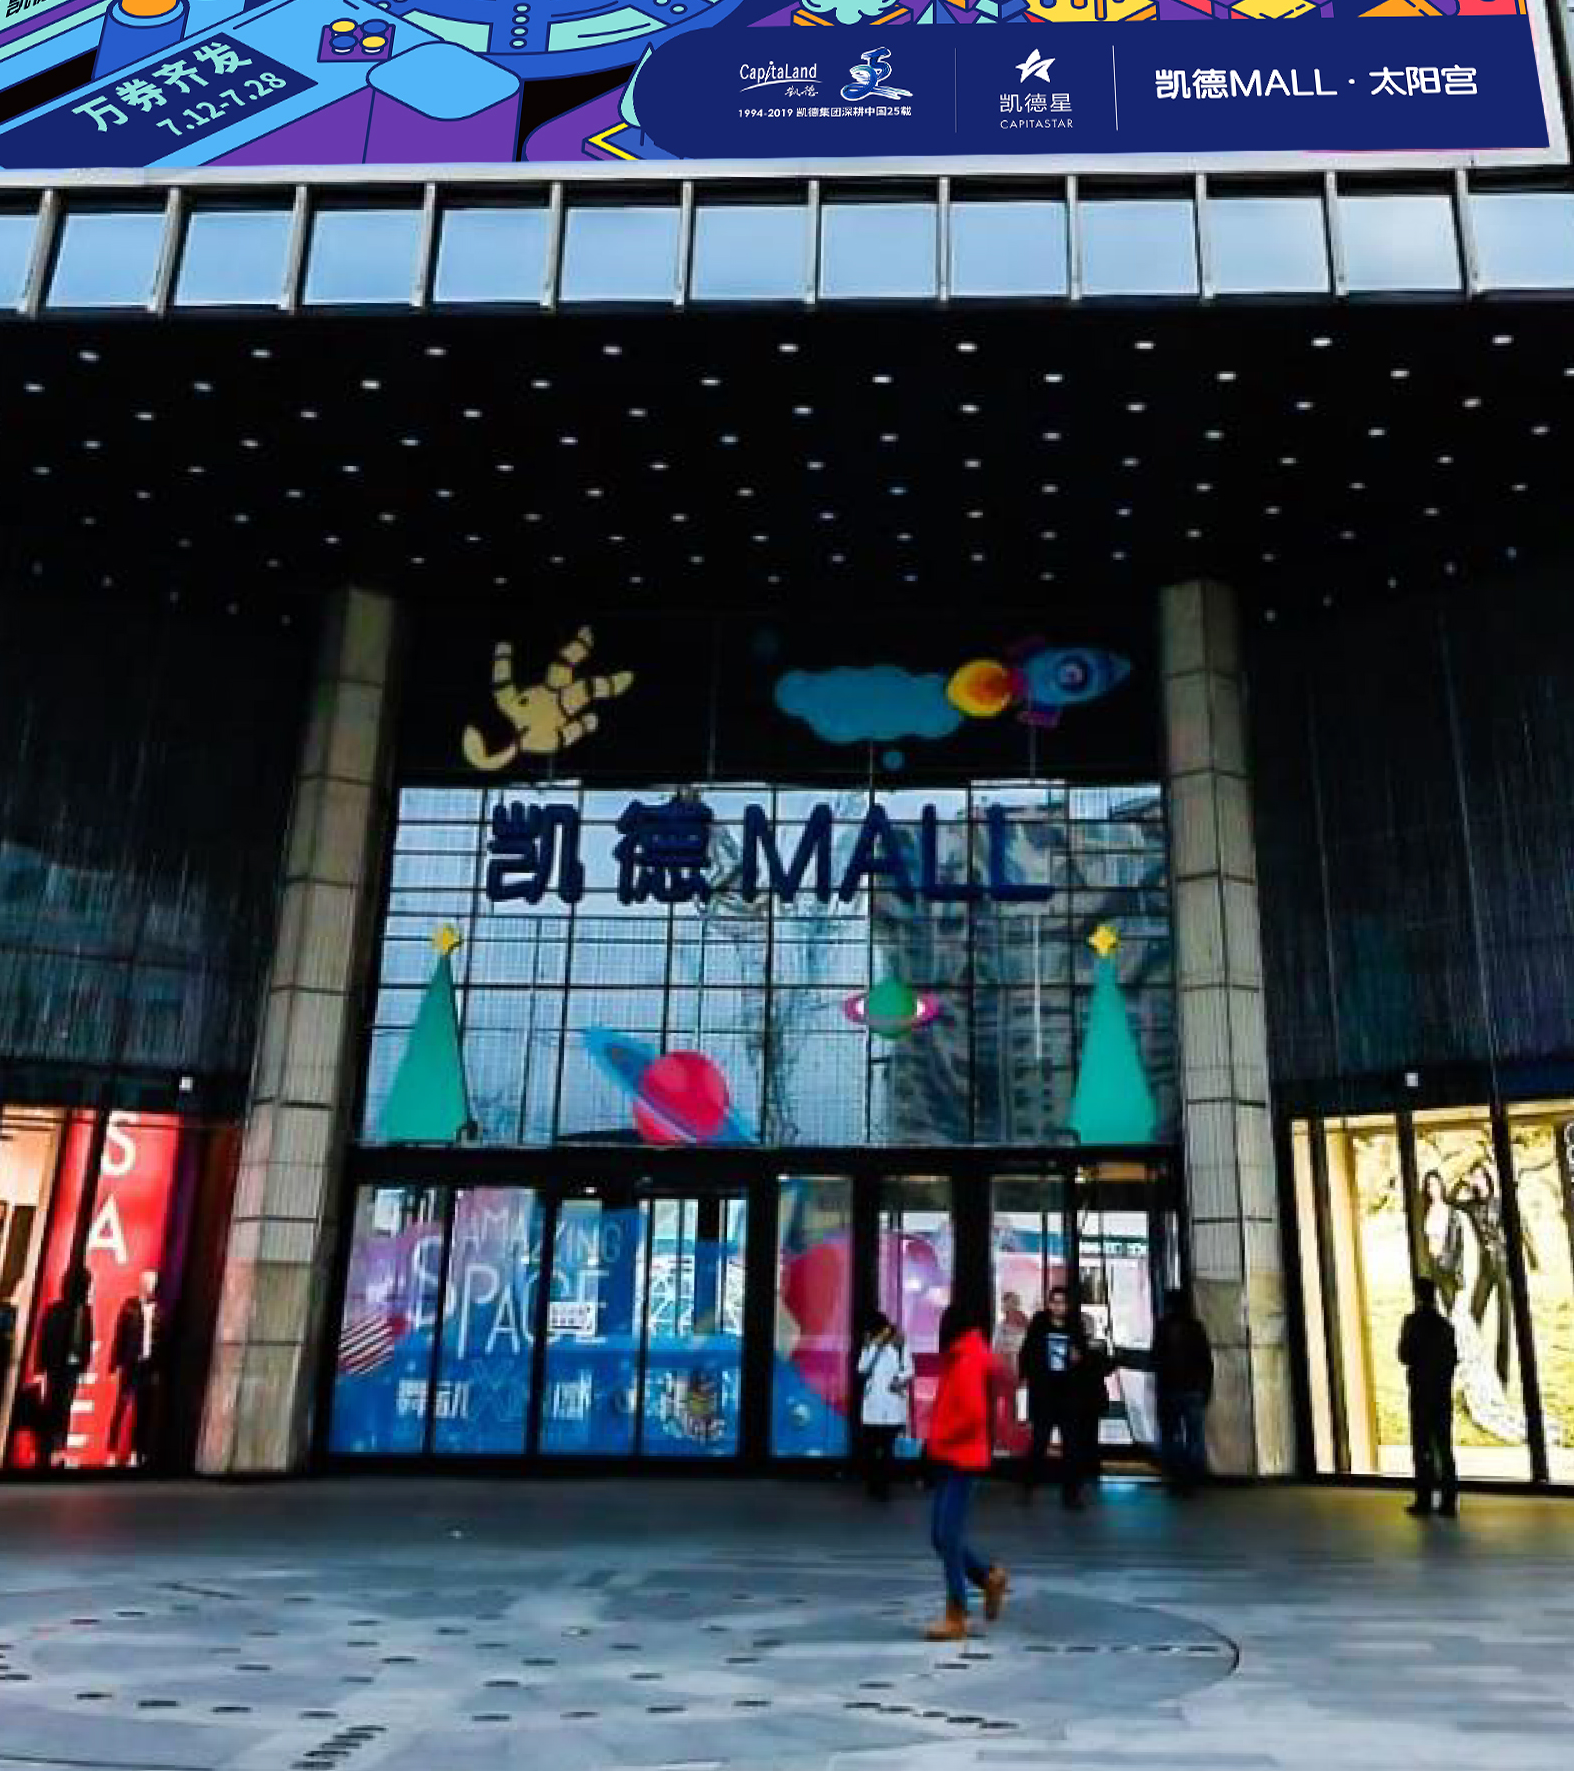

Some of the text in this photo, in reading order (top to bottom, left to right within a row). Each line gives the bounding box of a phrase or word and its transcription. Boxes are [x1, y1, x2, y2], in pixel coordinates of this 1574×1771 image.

[72, 42, 253, 132] 万券齐发
[739, 61, 818, 83] CapitaLand
[1155, 68, 1338, 100] 凯德MALL
[1368, 64, 1479, 97] 太阳宫
[156, 72, 287, 136] 7.12-7.28
[738, 108, 794, 118] 1994-2019
[999, 93, 1073, 114] 凯德星
[1000, 118, 1074, 130] CAPITASTAR
[485, 801, 1057, 906] 凯德 MALL
[67, 1110, 139, 1452] SAE
